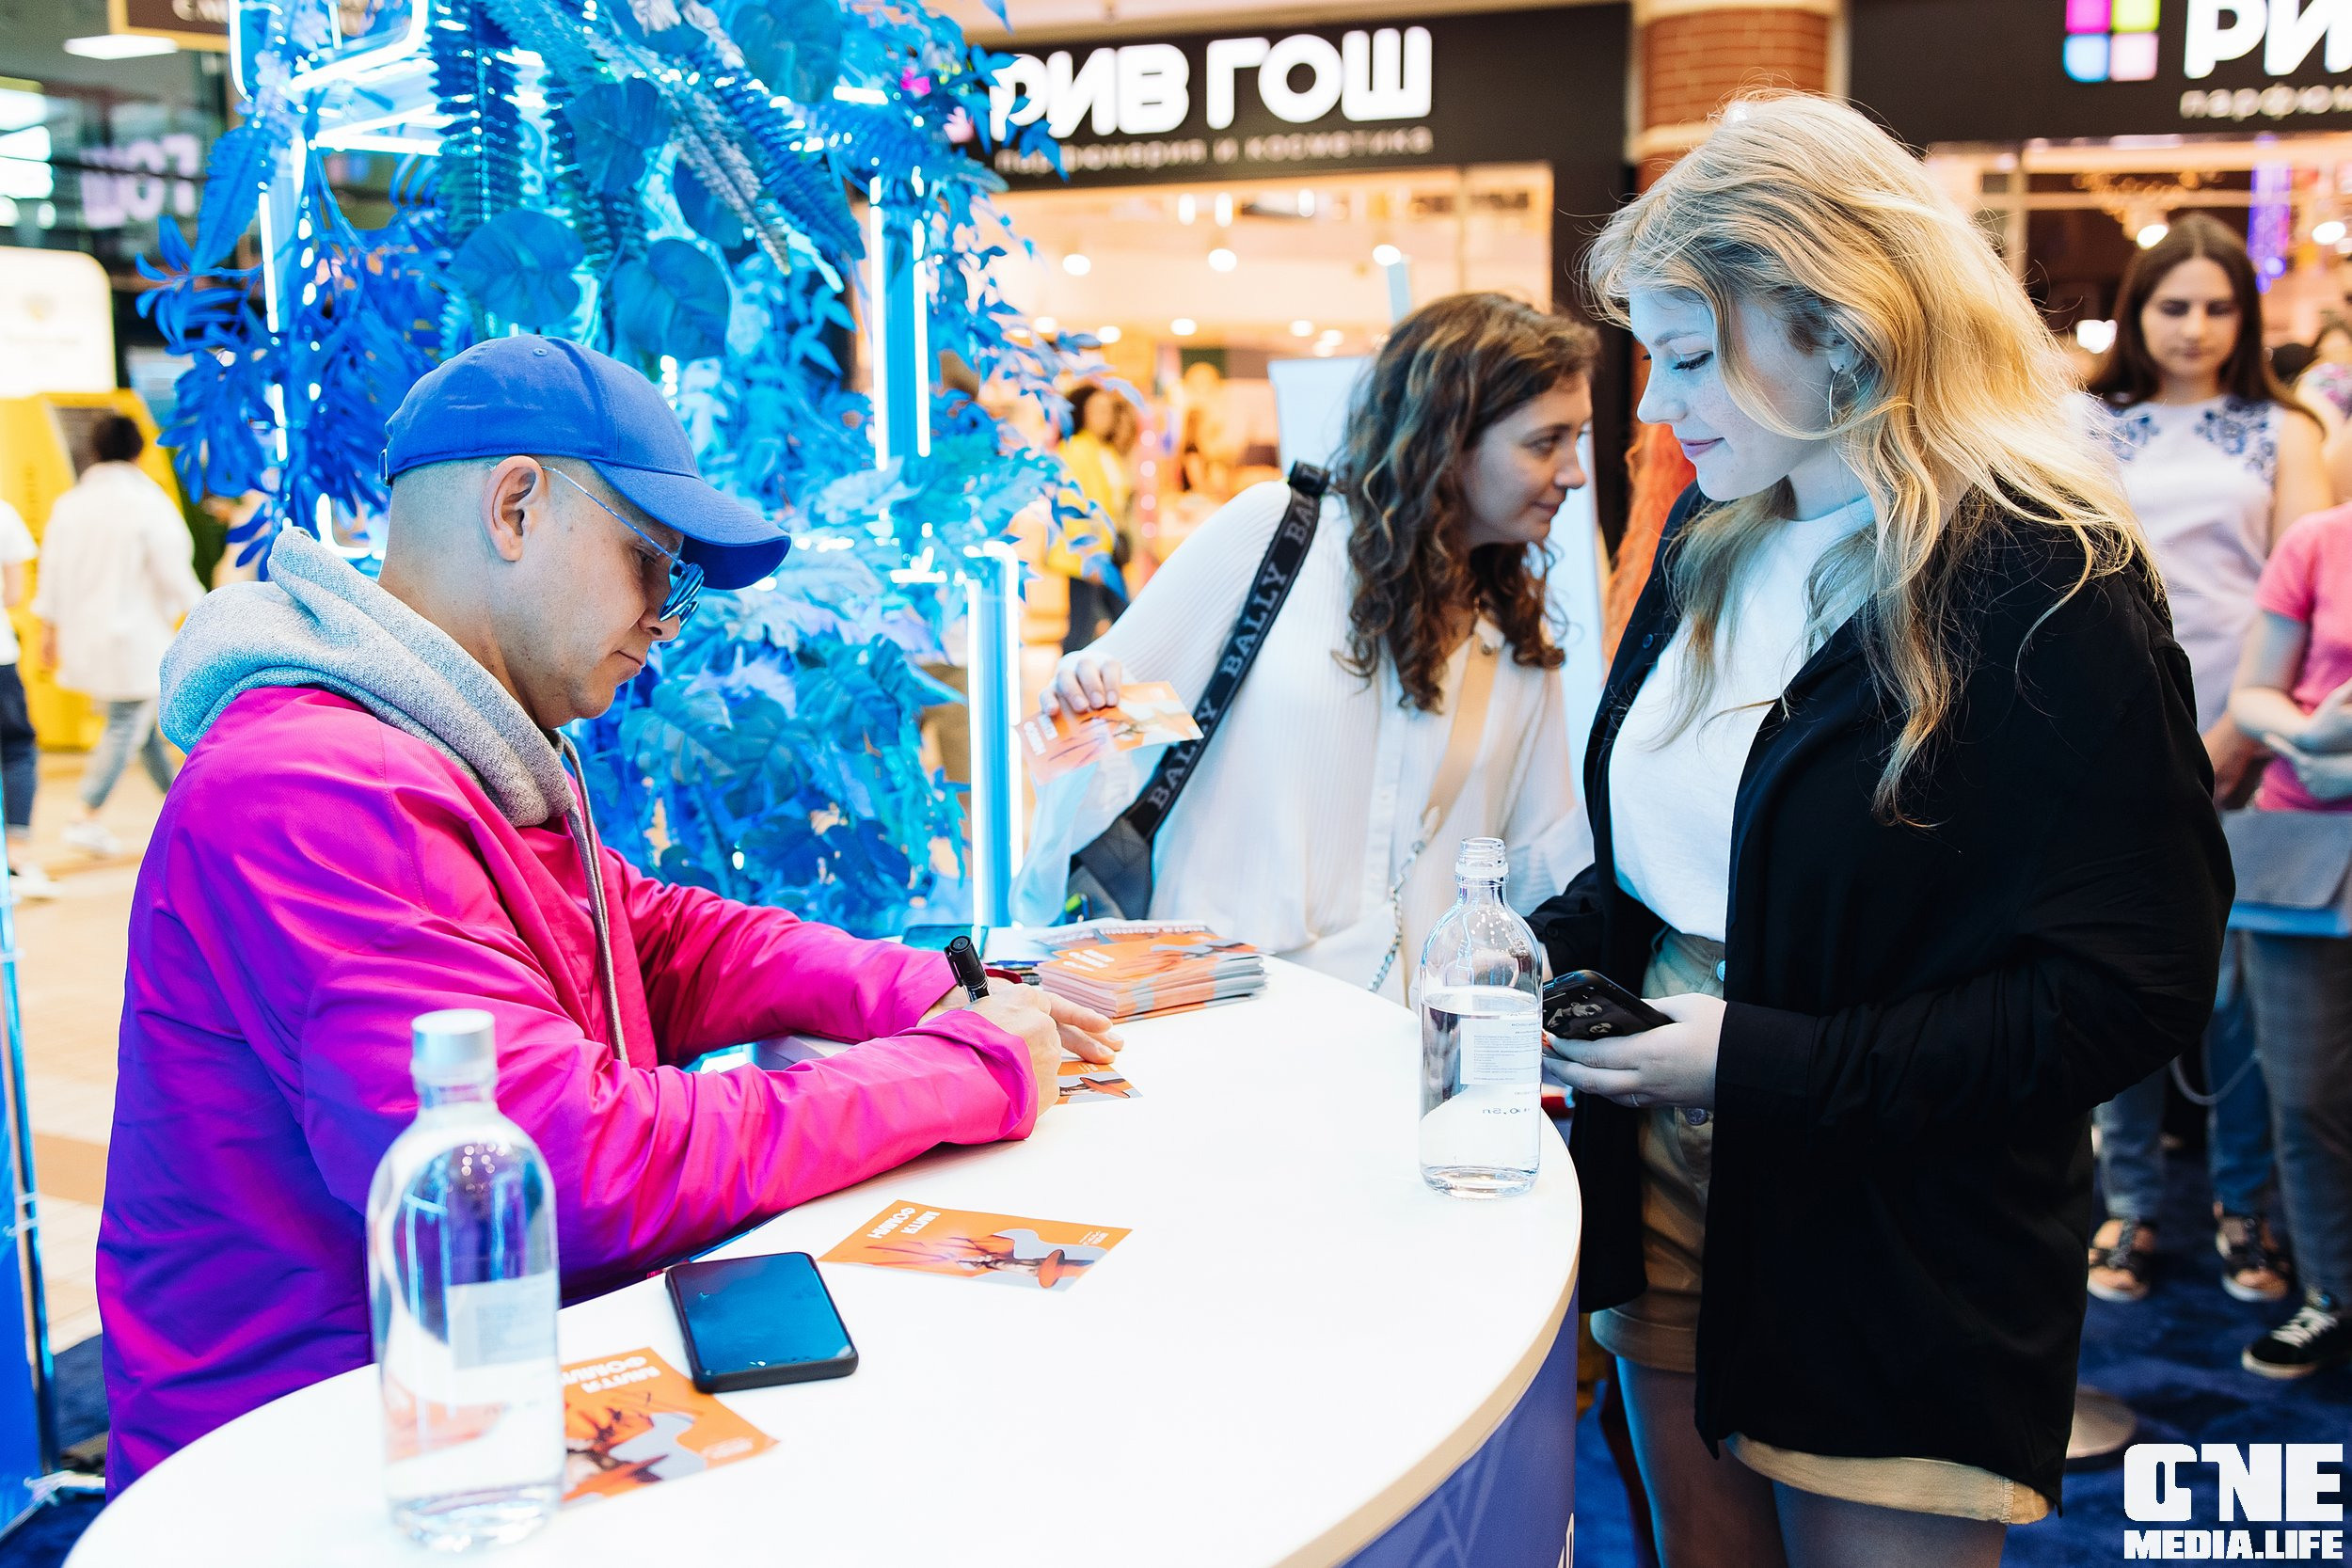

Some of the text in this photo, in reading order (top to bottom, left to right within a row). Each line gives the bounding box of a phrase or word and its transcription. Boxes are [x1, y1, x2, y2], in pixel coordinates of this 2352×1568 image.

[990, 26, 1432, 141] РИВ ГОШ
[1220, 562, 1288, 676] BALLY
[1148, 697, 1218, 809] BALY
